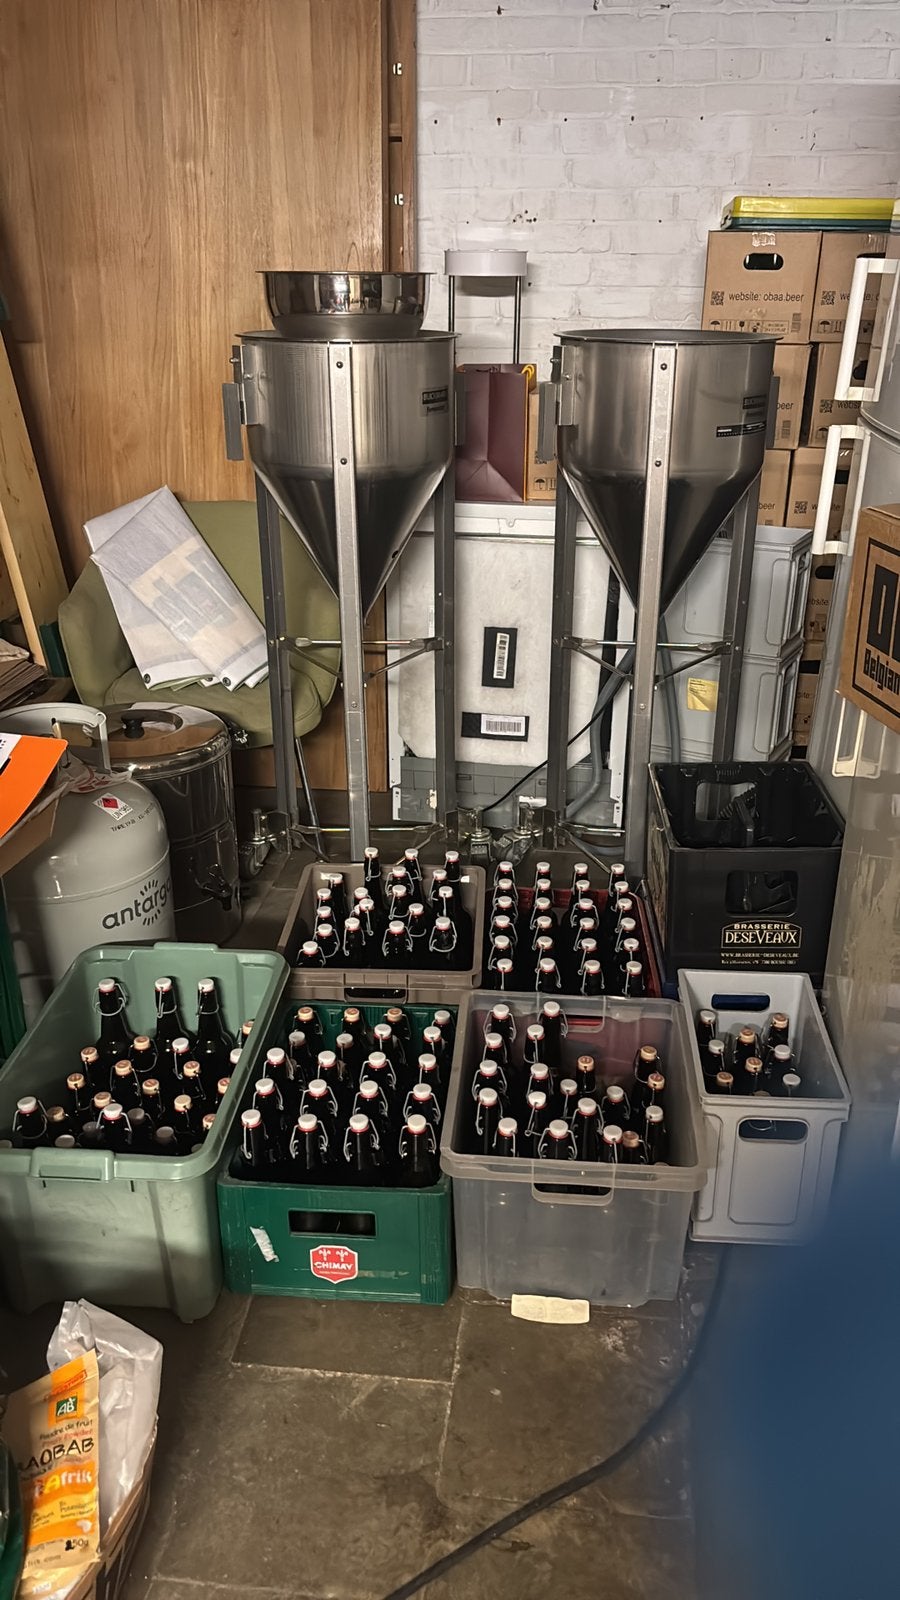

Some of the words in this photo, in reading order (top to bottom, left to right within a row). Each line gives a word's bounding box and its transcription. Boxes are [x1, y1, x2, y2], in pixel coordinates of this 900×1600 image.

[729, 291, 761, 301] website:
[763, 292, 804, 302] obaa.beer
[863, 648, 900, 695] Belgian
[725, 930, 797, 944] DESEVEAUX
[314, 1261, 353, 1270] CHIMAY
